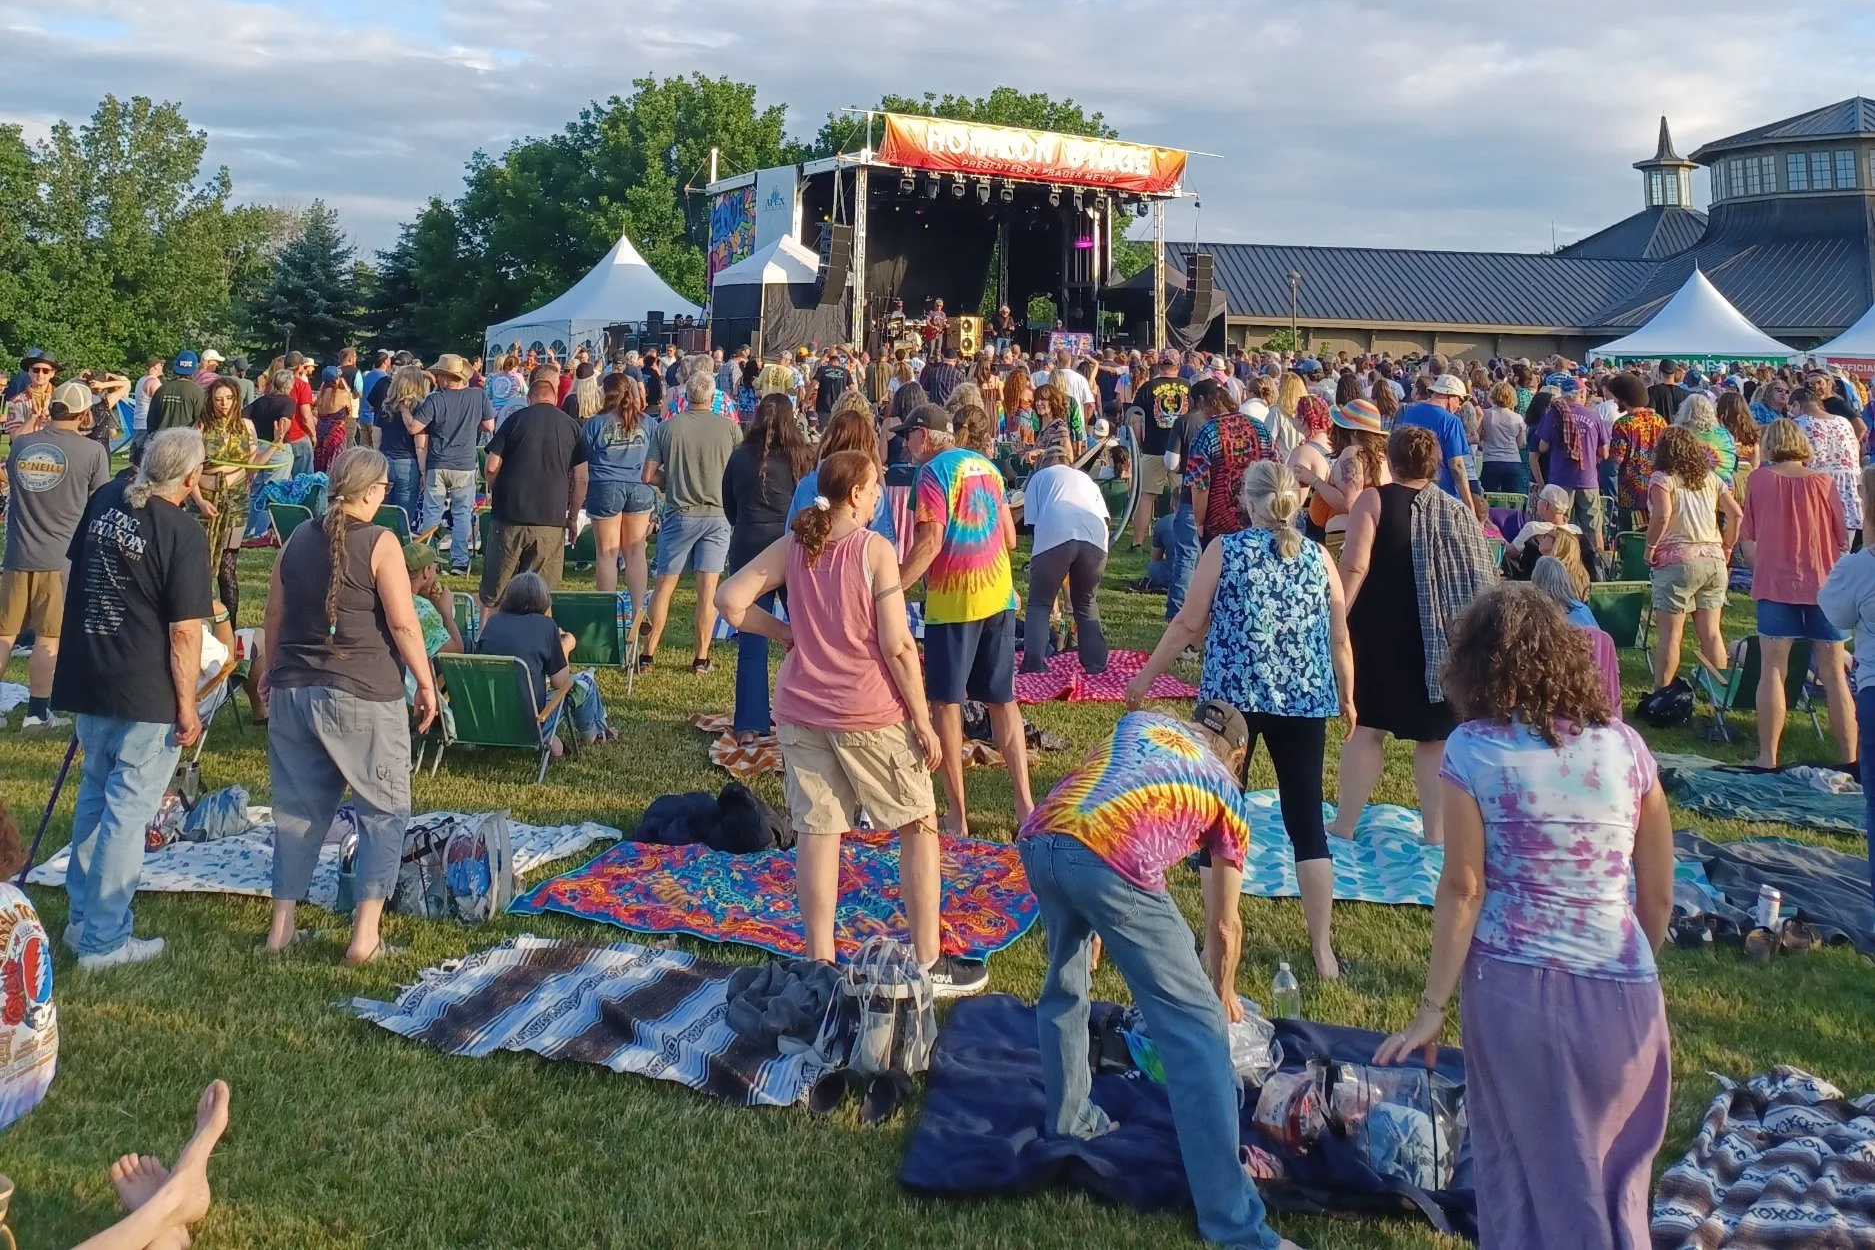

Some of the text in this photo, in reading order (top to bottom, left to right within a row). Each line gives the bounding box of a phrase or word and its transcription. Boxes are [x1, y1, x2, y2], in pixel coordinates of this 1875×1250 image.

[961, 159, 1116, 183] PRESENTED BY PRAGER METIS
[19, 461, 62, 473] O'NEILL
[100, 507, 140, 533] KING
[125, 550, 141, 561] 2017
[930, 972, 953, 984] HOKA
